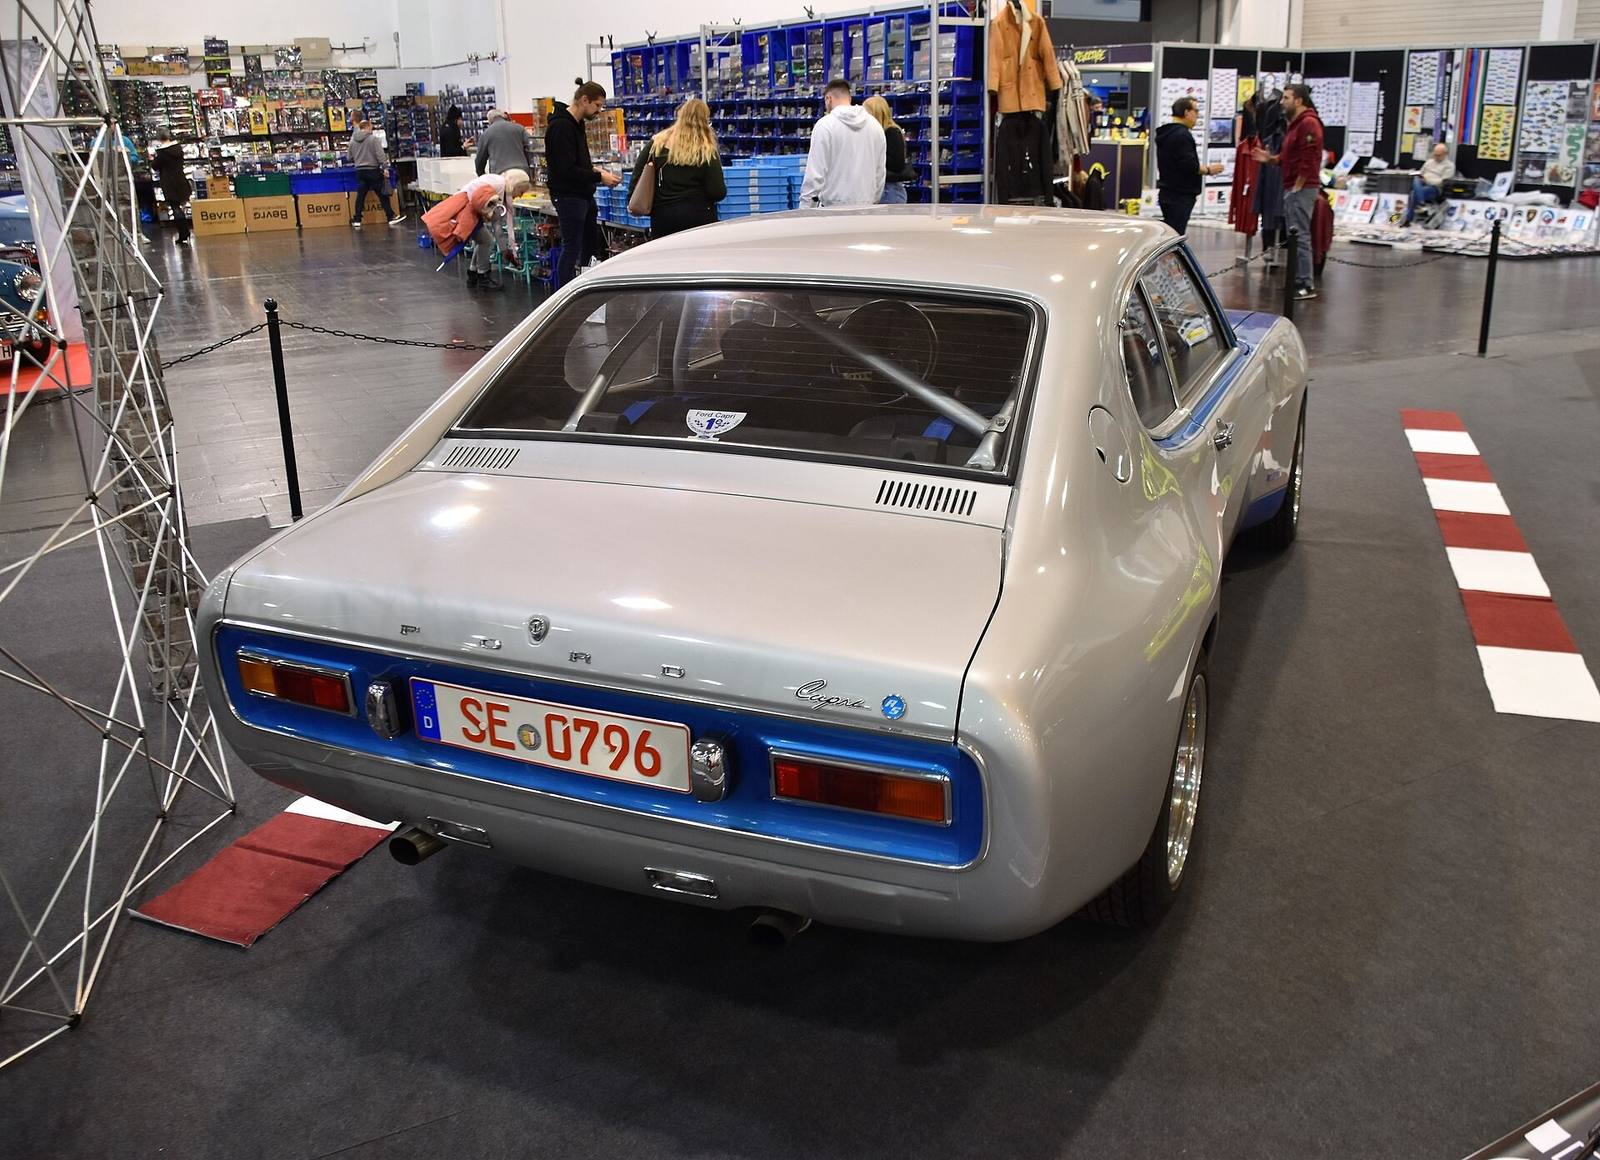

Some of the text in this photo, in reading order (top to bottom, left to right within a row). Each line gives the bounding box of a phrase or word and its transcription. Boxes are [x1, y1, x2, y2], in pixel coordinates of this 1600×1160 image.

[423, 715, 433, 729] D
[460, 697, 661, 777] SE 0796
